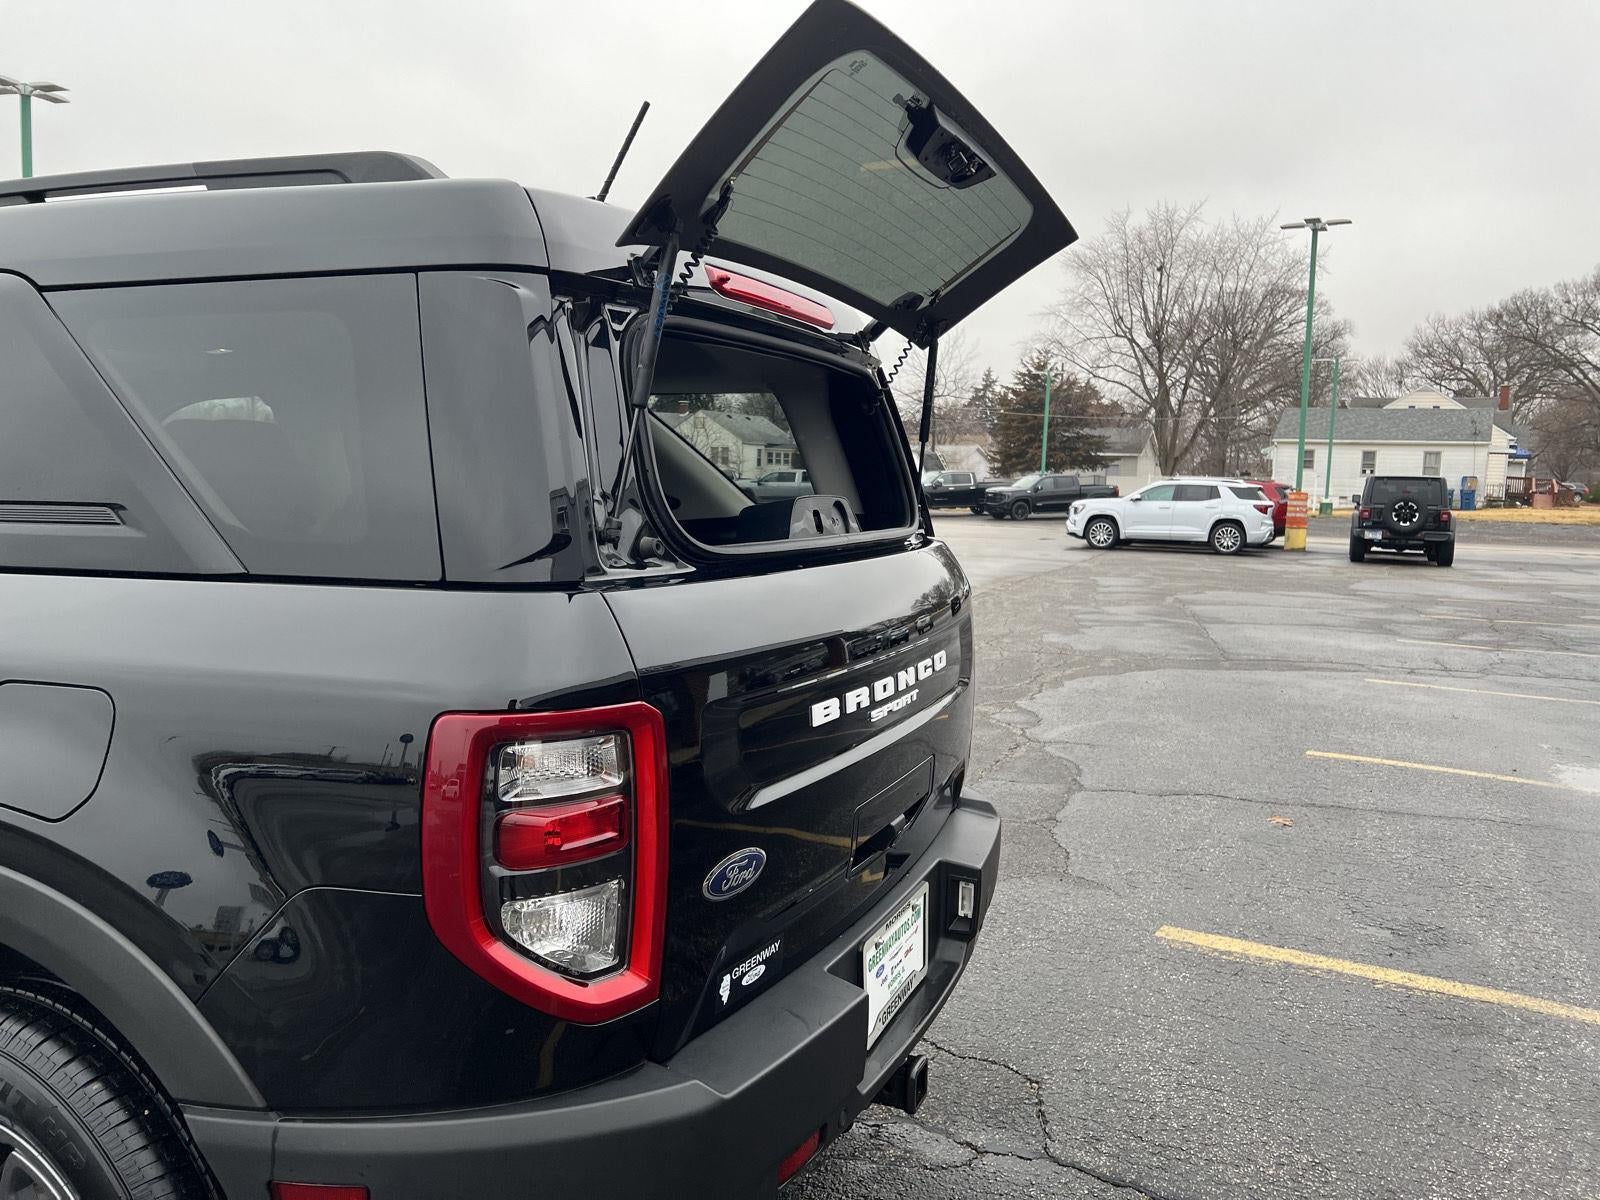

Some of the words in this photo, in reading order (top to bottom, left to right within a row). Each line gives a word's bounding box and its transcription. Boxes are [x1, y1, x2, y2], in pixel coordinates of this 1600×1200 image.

[811, 650, 947, 727] BRONCO
[870, 688, 920, 723] SPORT
[721, 858, 757, 892] Ford
[885, 900, 911, 930] MORRIS
[731, 940, 781, 981] GREENWAY
[881, 976, 914, 1026] GREENWAY
